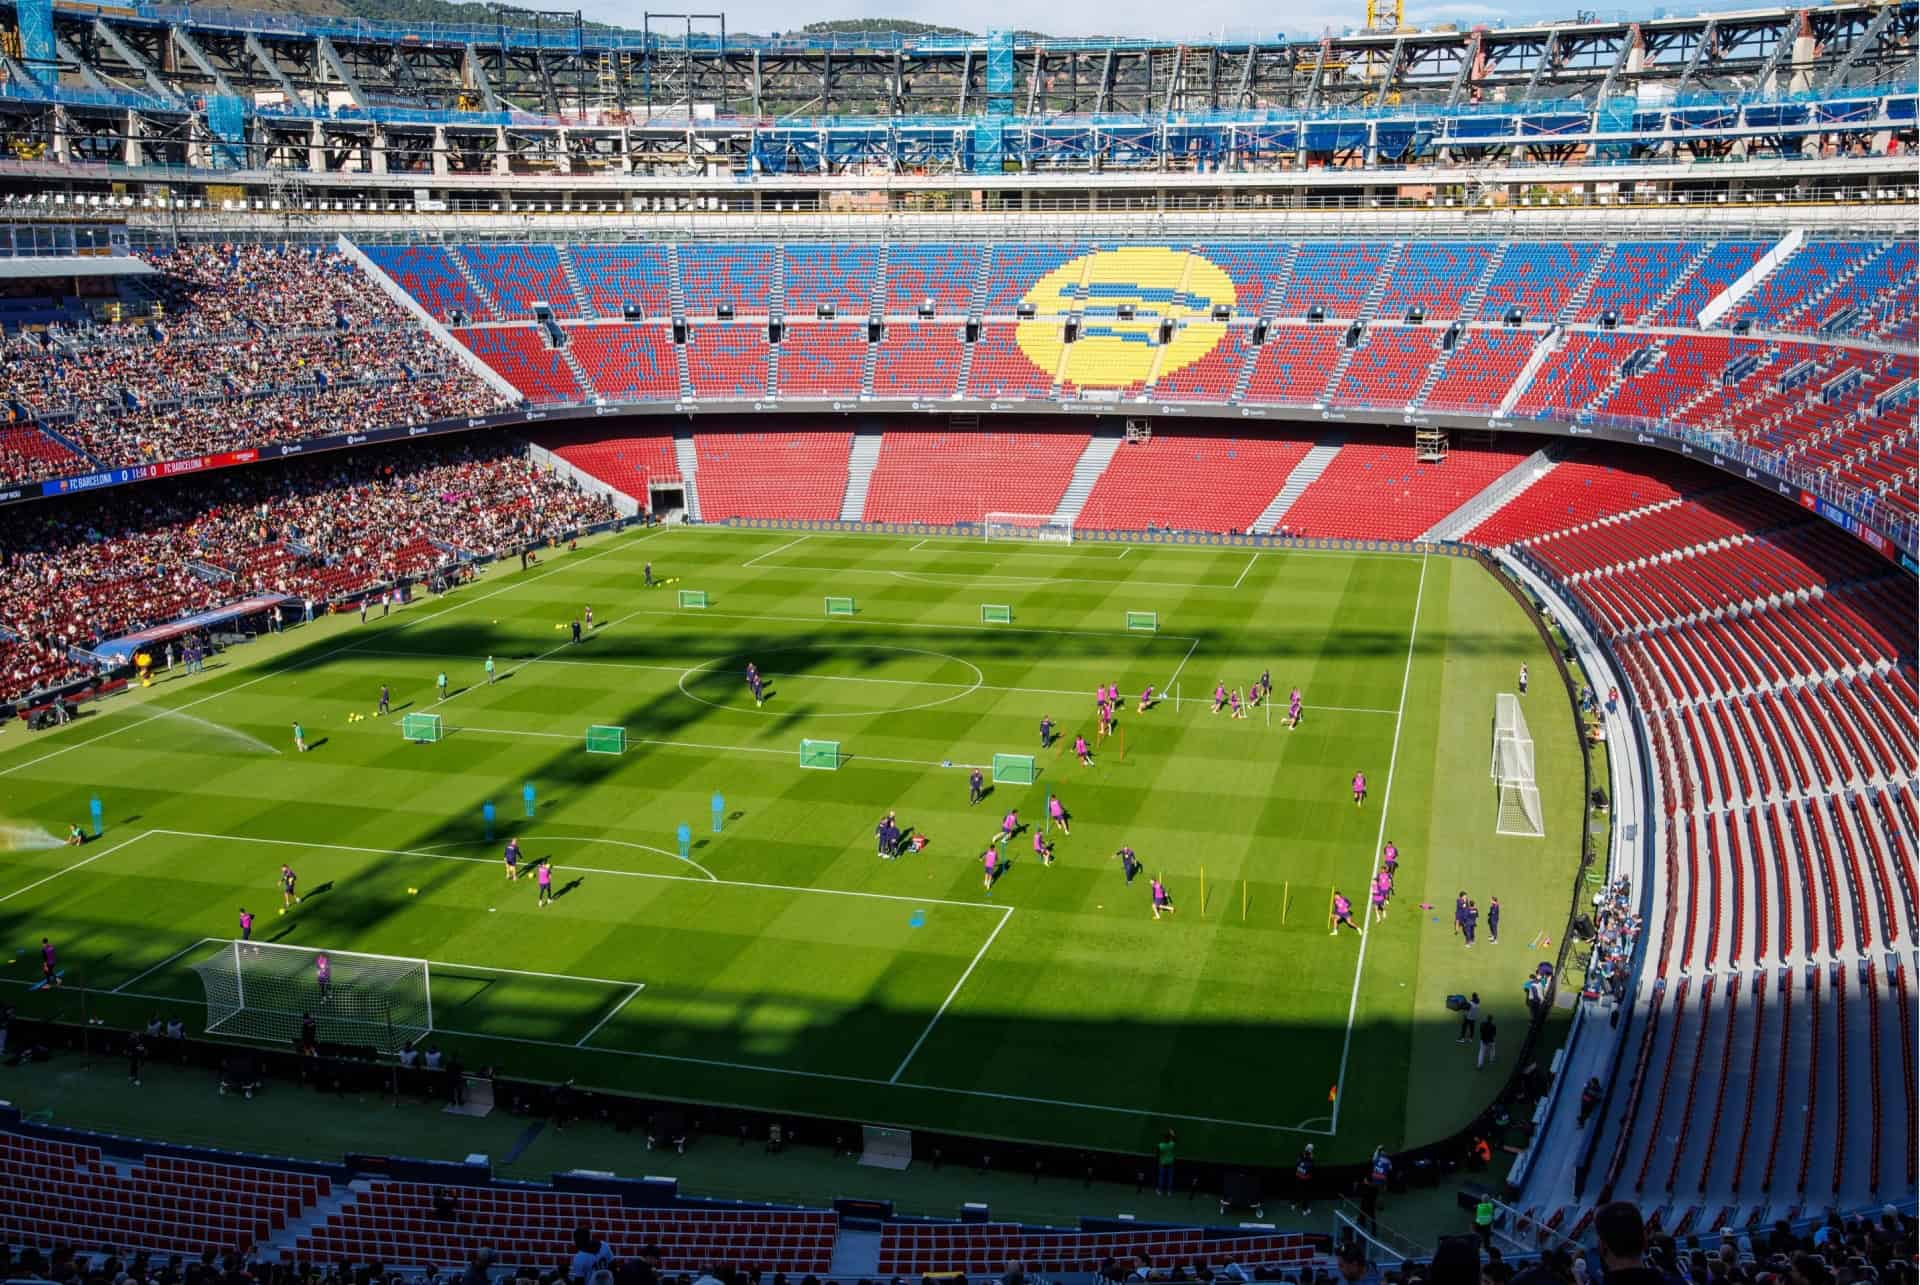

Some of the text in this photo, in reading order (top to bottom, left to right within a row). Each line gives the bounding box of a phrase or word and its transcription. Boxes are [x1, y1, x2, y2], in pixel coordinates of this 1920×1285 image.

[70, 479, 78, 489] FC
[79, 473, 112, 488] BARCELONA
[122, 470, 128, 480] 0
[150, 466, 156, 476] 0
[164, 464, 171, 473] FC
[172, 459, 202, 472] BARCELONA
